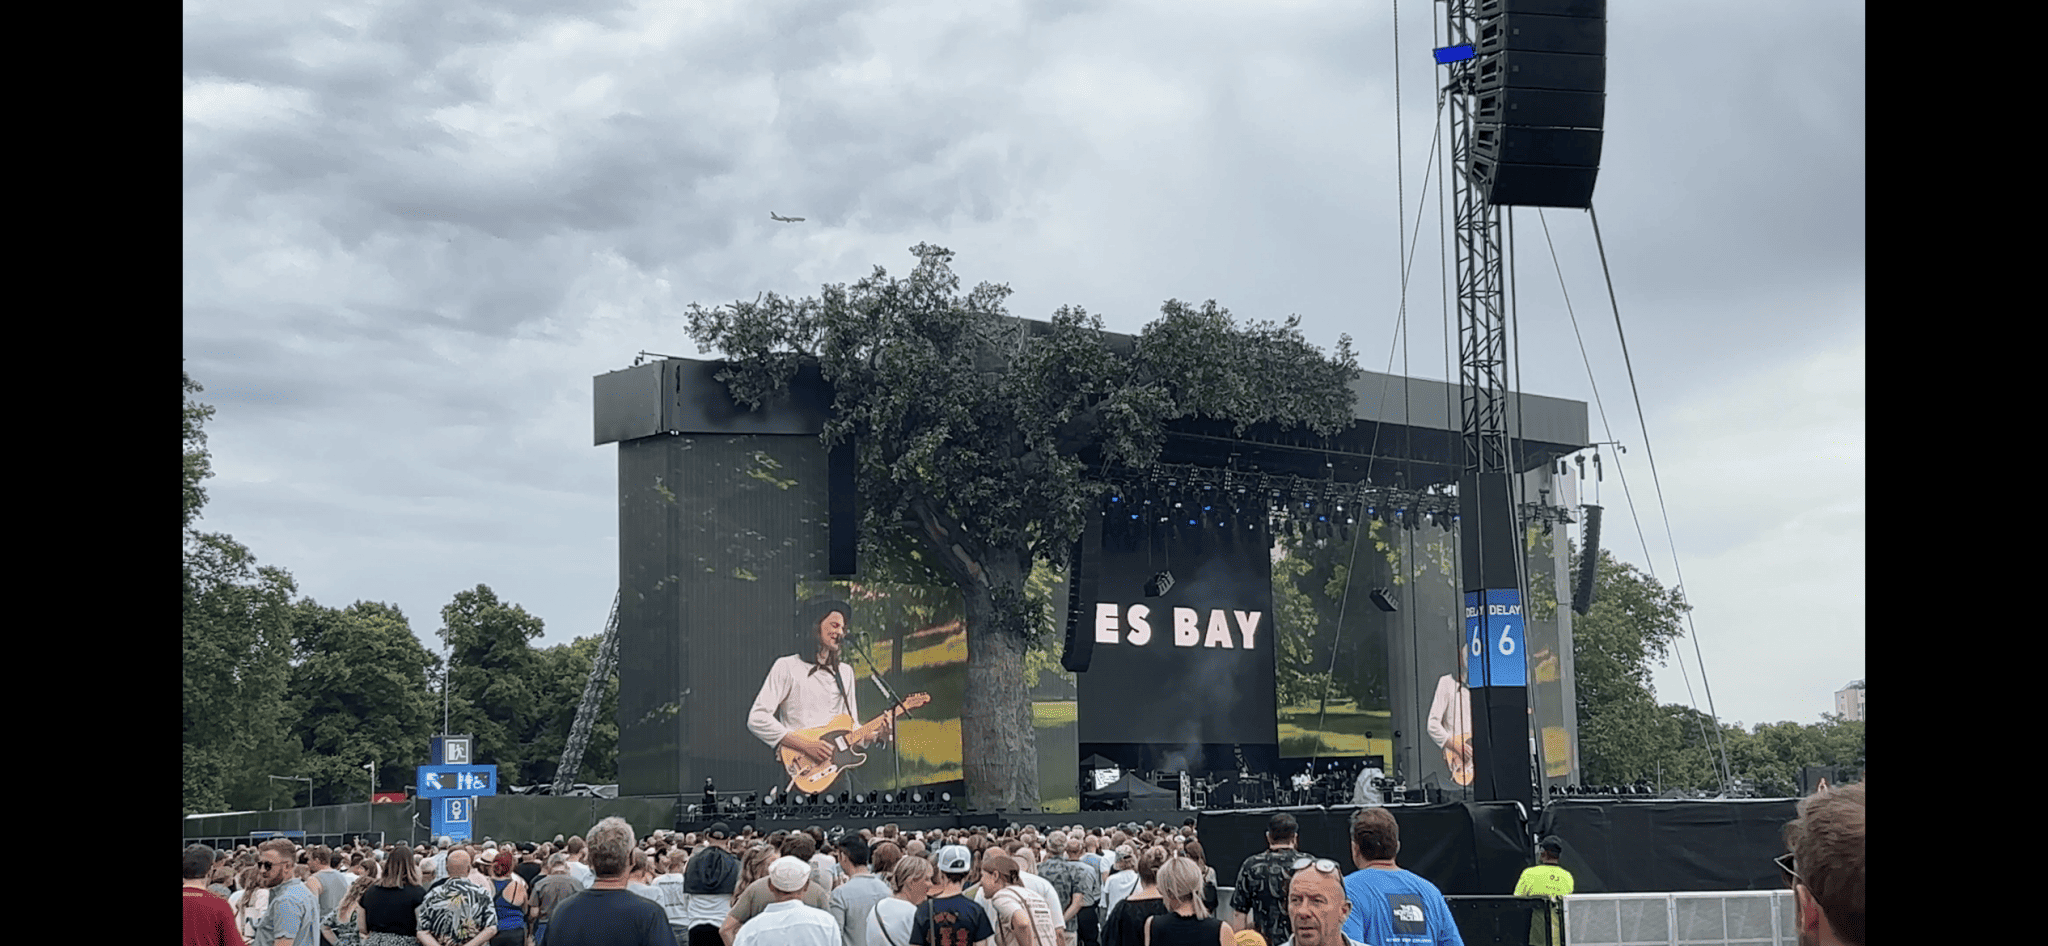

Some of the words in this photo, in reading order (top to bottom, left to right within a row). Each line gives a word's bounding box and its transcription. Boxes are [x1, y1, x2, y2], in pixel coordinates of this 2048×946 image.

[1489, 605, 1521, 615] DELAY
[1095, 603, 1151, 646] ES
[1173, 607, 1262, 649] BAY
[1472, 626, 1481, 656] 6
[1499, 625, 1515, 655] 6
